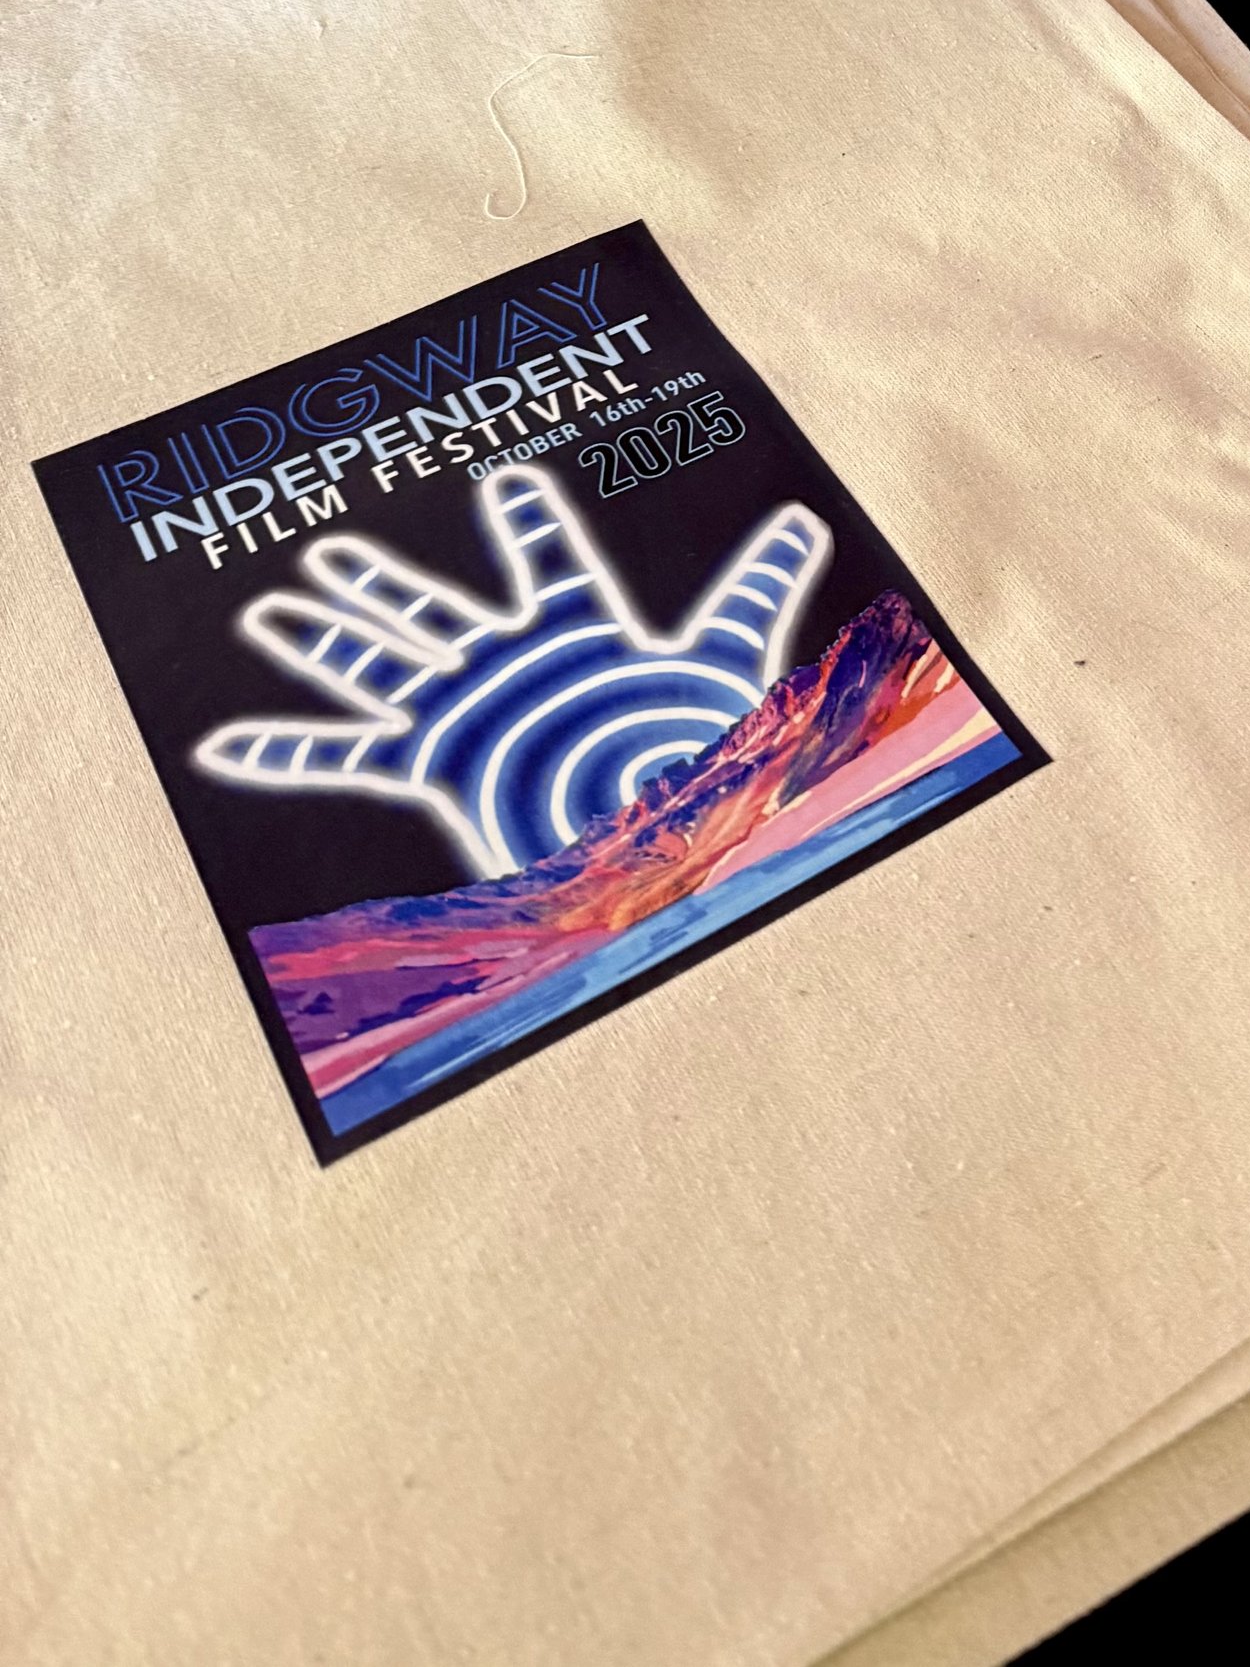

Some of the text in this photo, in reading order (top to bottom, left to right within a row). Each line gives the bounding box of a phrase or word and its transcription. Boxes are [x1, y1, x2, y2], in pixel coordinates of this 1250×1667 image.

[97, 262, 607, 524] RIDGWAY
[130, 313, 653, 562] INDEPENDENT
[201, 369, 639, 570] FILM FESTIVAL
[466, 370, 707, 482] OCTOBER 16th-19th
[578, 390, 746, 499] 2025
